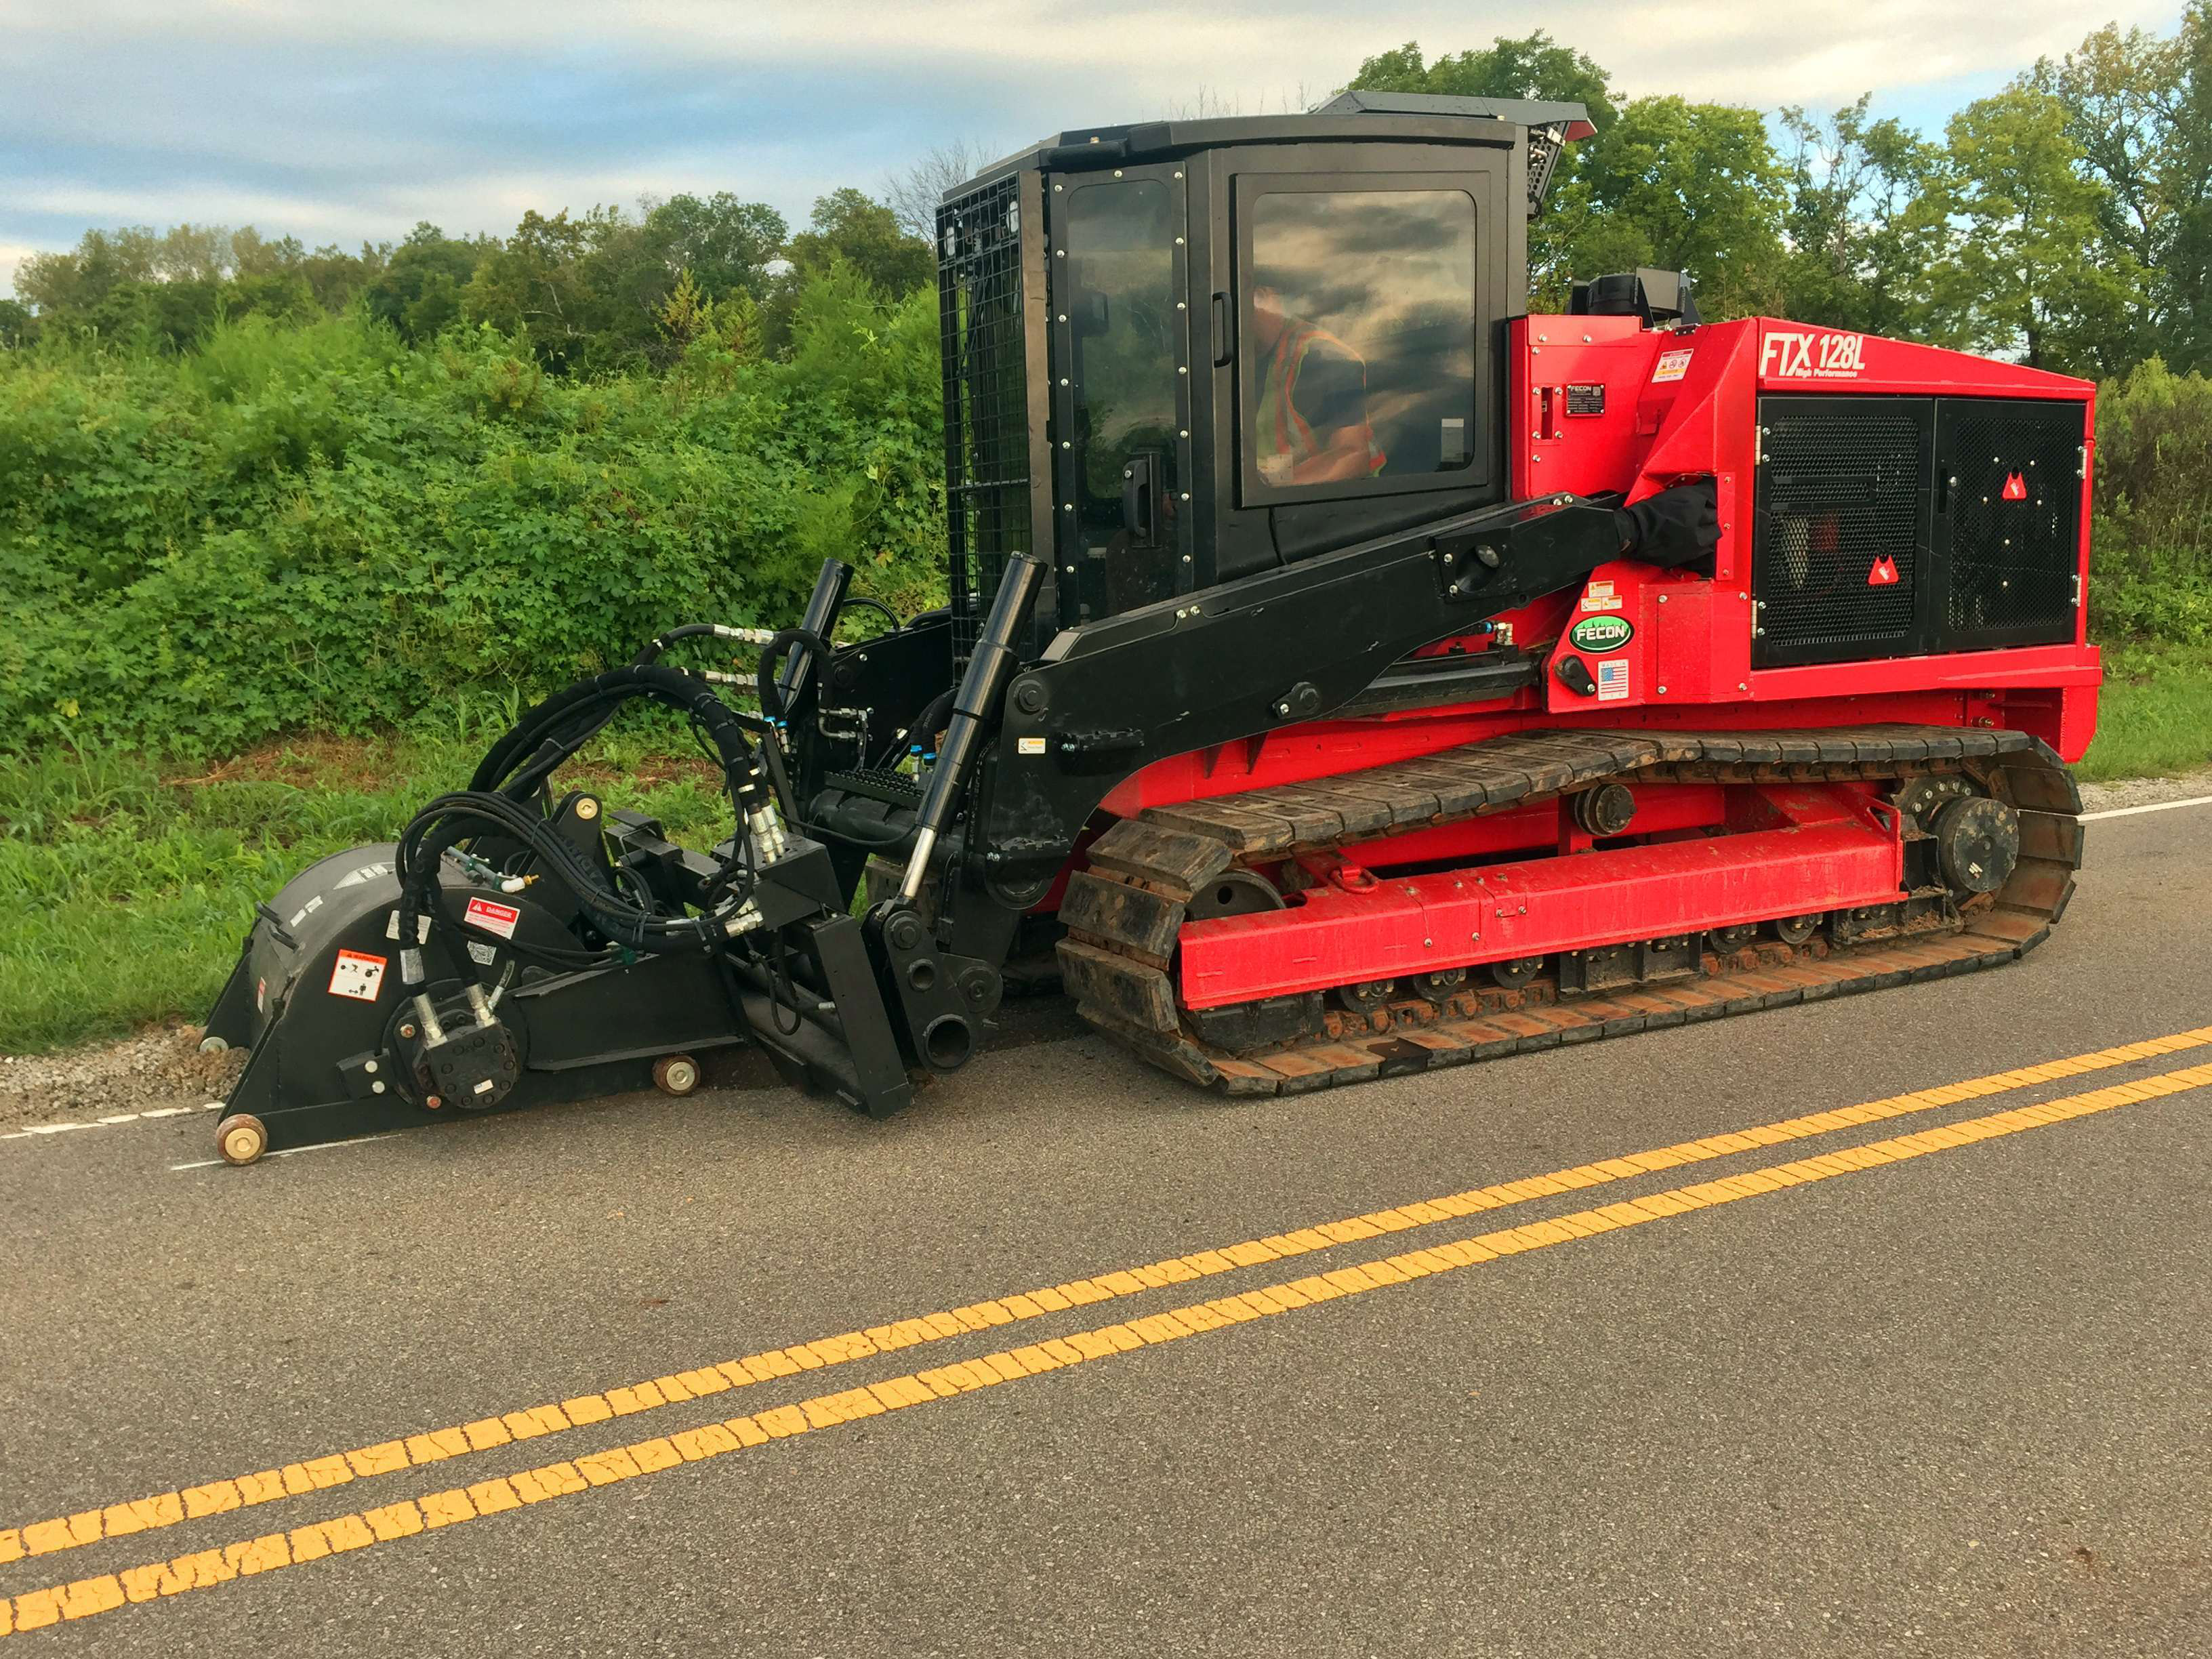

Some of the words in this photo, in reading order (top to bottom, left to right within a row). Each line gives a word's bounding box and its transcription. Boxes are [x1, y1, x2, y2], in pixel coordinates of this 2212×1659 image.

[1759, 332, 1816, 376] FTX
[1819, 334, 1865, 369] 128L
[1795, 367, 1811, 378] High
[1813, 368, 1858, 377] Performance
[1576, 625, 1625, 641] FECON
[486, 906, 512, 919] DANGER
[353, 954, 380, 963] WARNING
